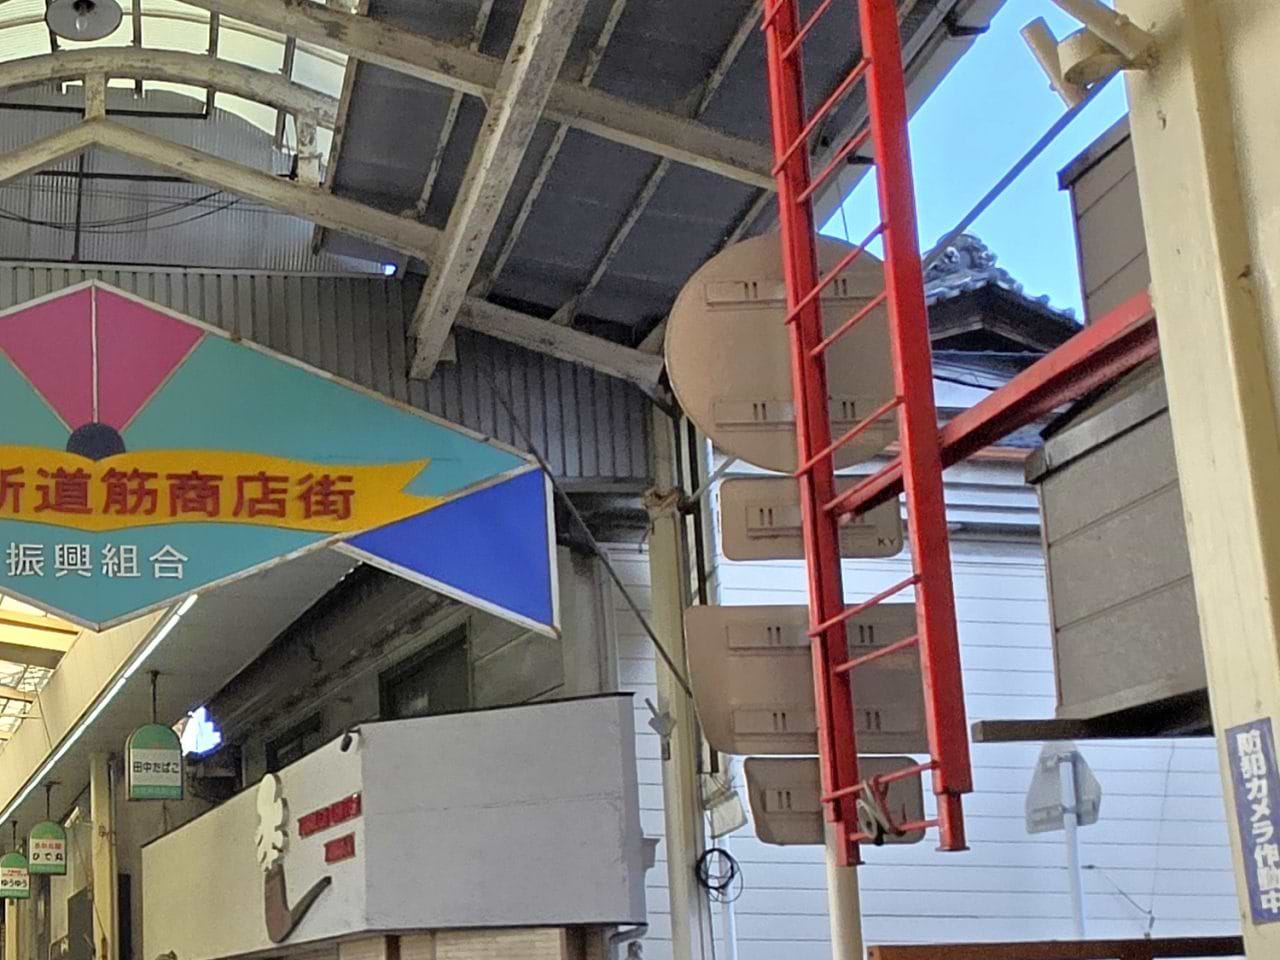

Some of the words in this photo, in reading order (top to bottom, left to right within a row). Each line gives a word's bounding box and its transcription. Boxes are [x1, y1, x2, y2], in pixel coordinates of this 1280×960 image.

[6, 542, 188, 579] 振興組合
[133, 761, 179, 773] 田中たばこ
